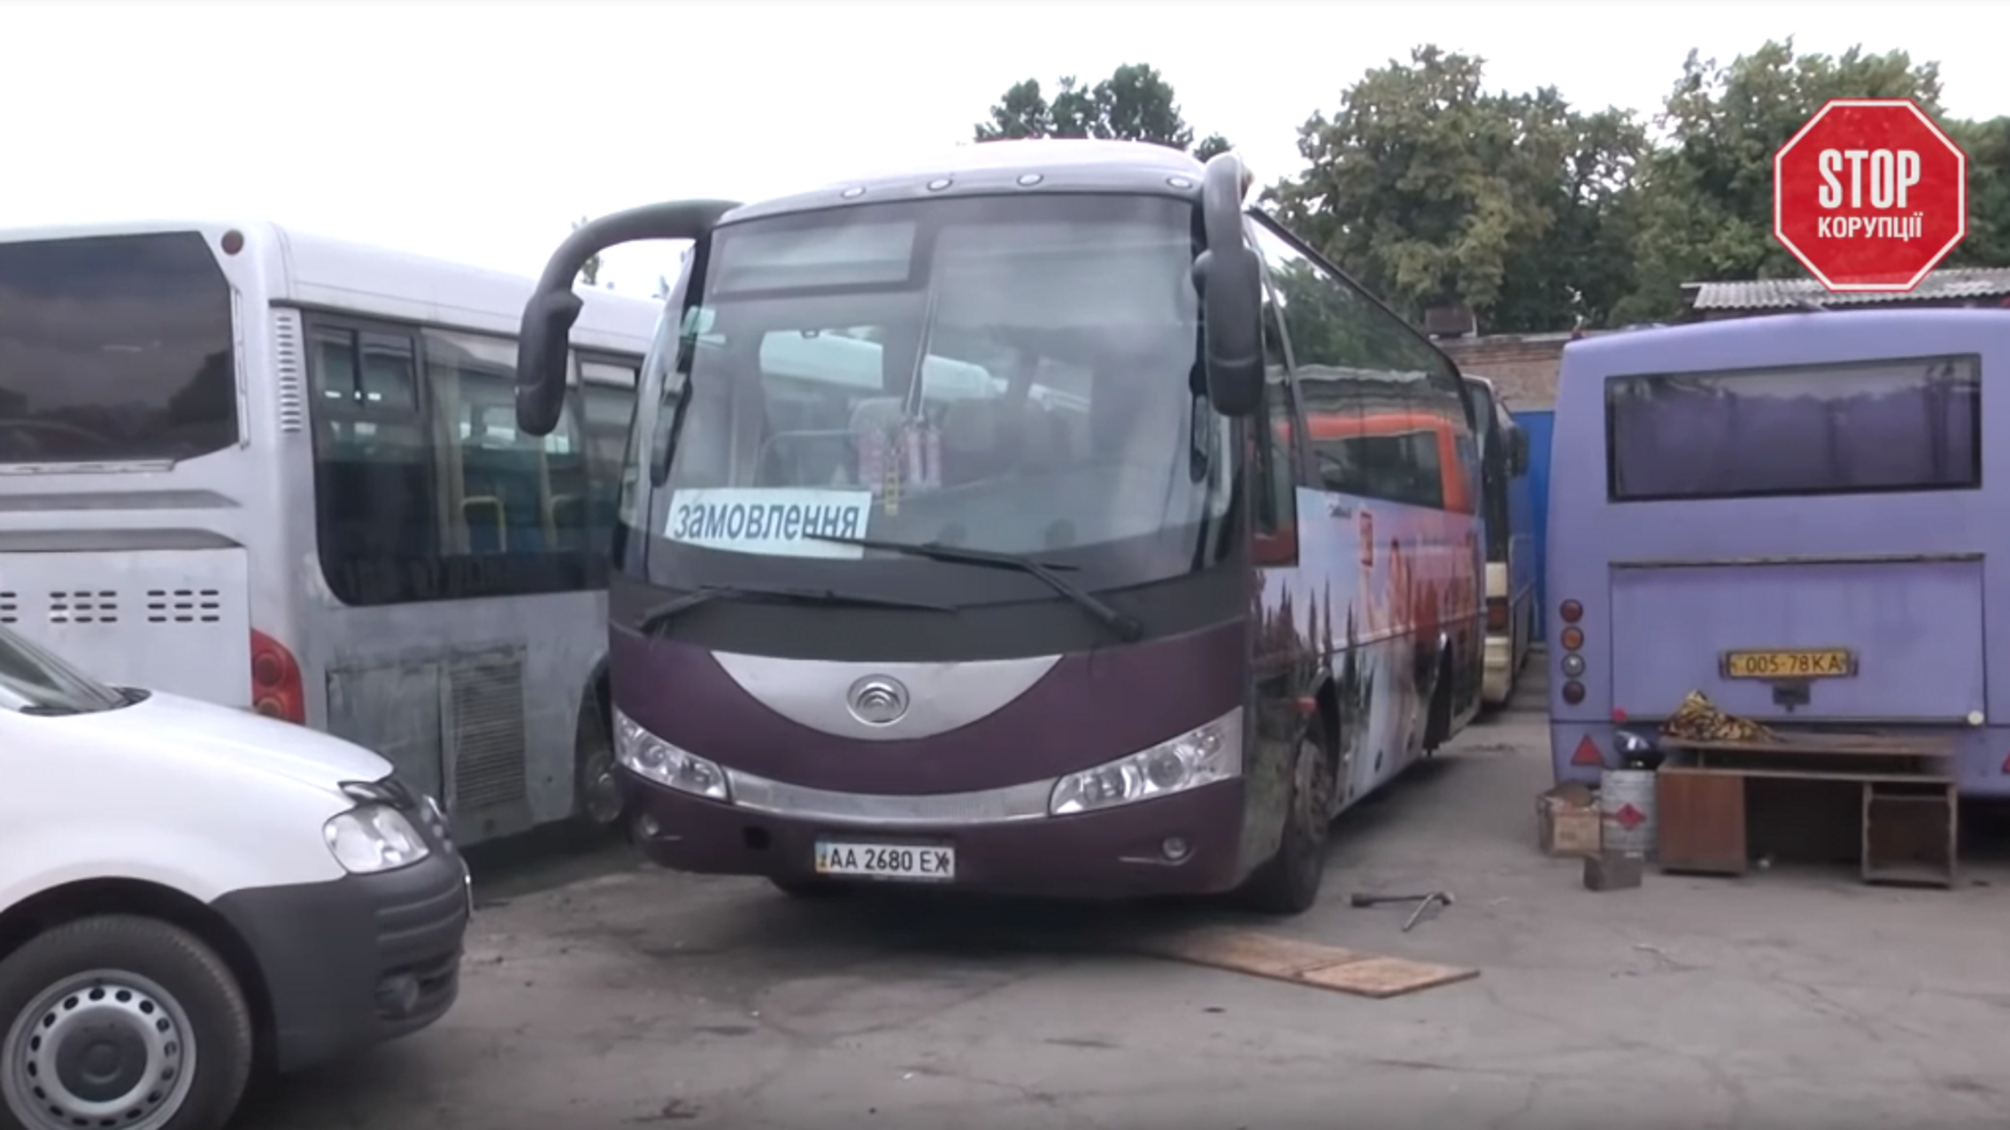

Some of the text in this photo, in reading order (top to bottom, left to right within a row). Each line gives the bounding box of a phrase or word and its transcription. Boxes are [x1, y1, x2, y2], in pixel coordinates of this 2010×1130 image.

[673, 502, 861, 541] замовлення
[830, 847, 858, 870] AA
[864, 849, 914, 872] 2680
